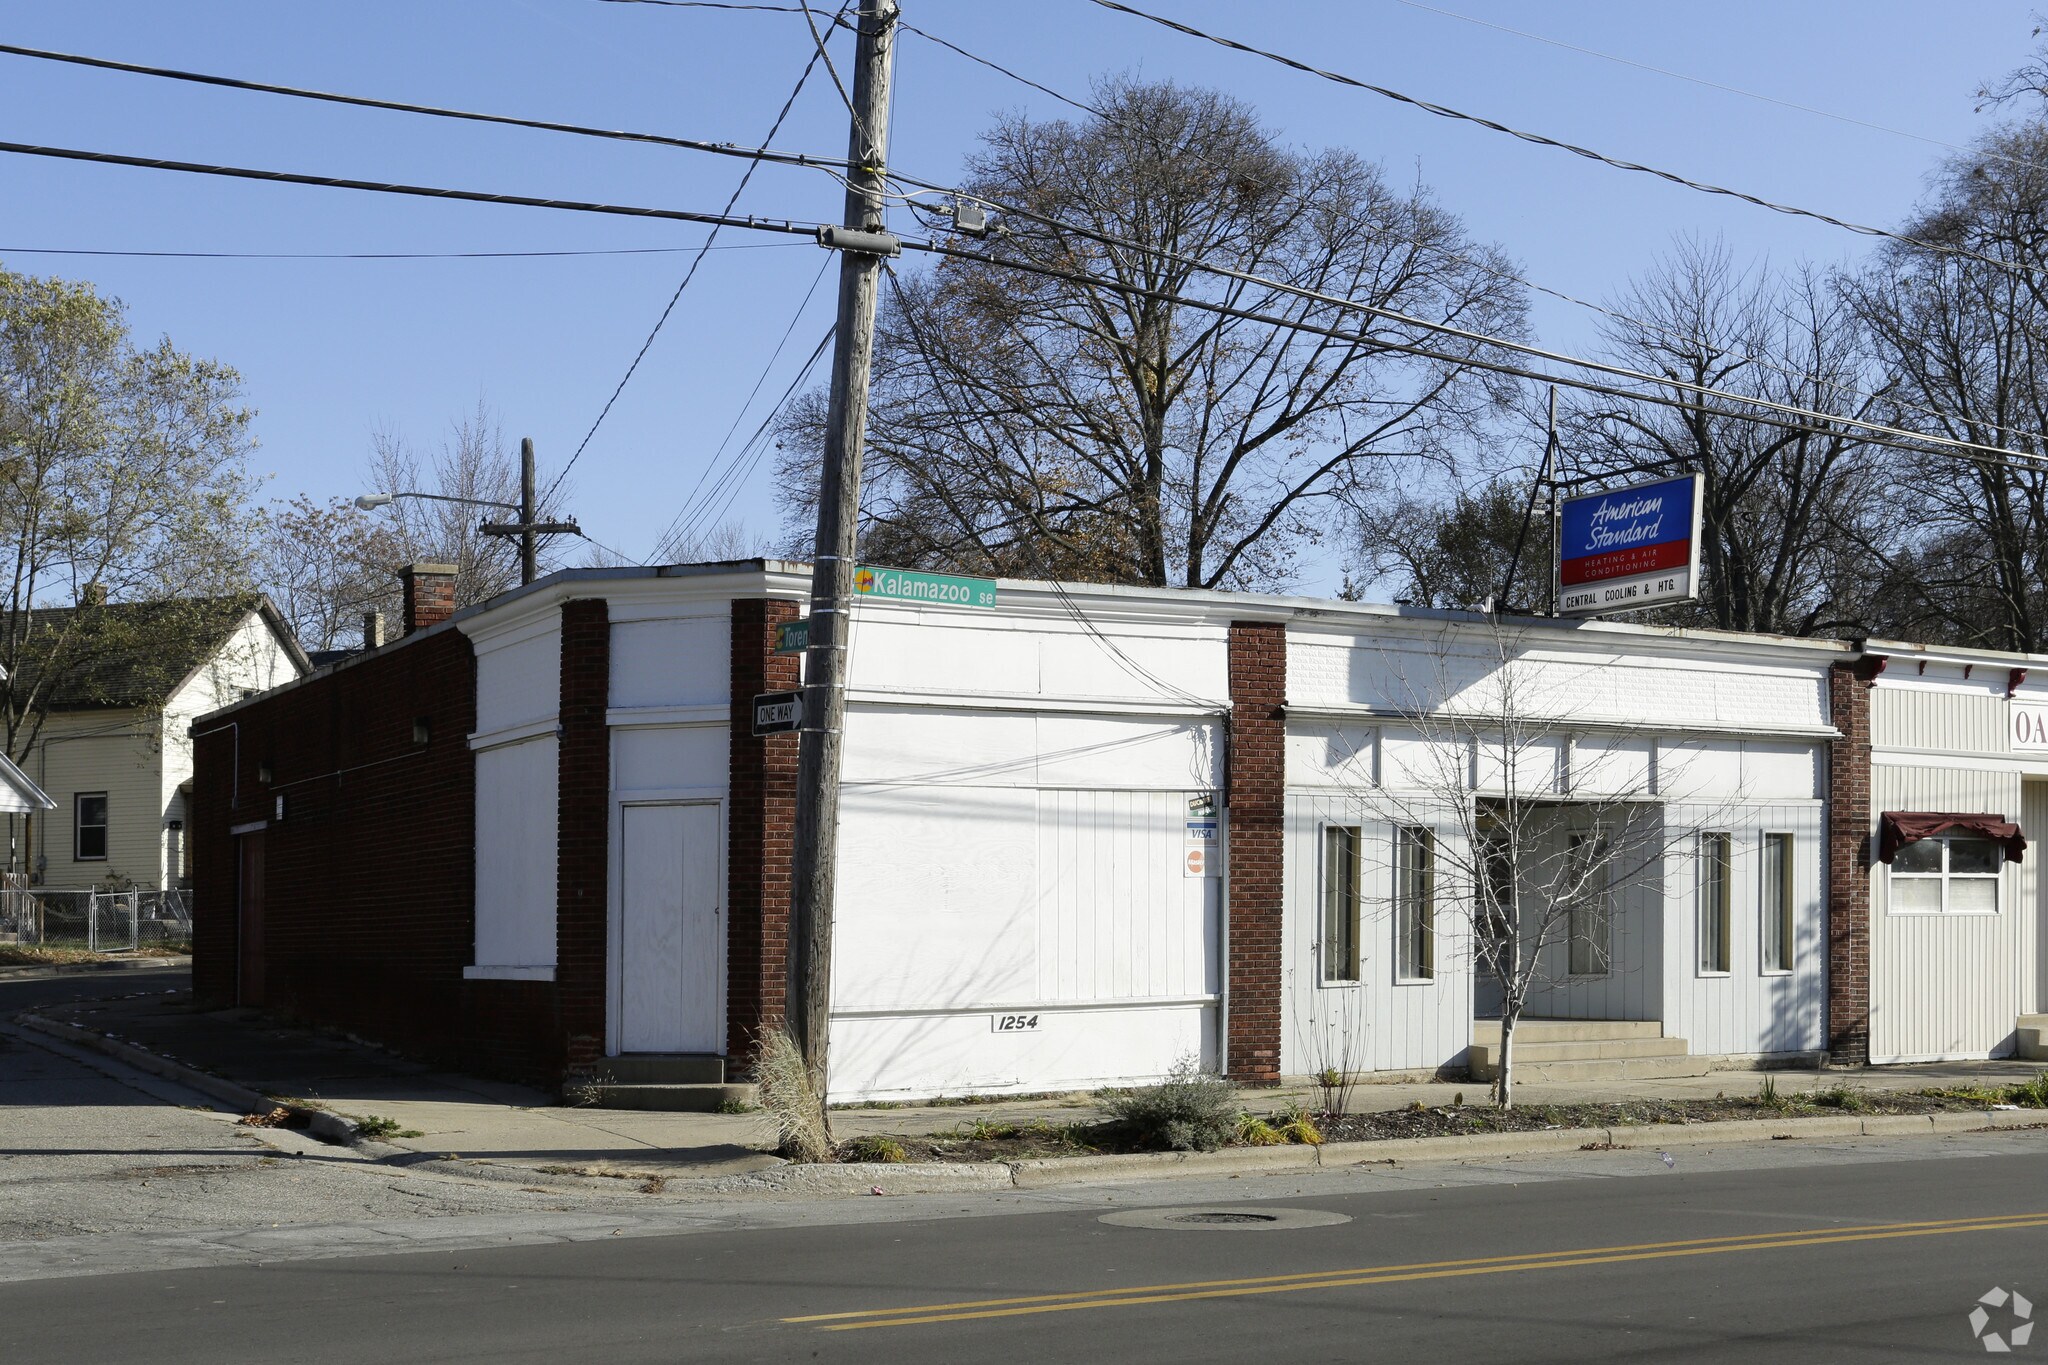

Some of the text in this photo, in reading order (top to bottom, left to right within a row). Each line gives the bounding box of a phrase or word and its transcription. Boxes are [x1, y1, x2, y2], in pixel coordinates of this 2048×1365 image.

[1590, 496, 1663, 527] American
[1584, 513, 1664, 550] Standard
[1584, 549, 1658, 568] HEATING & AIR
[1584, 559, 1657, 578] CONDITIONING
[873, 571, 971, 602] Kalamazoo
[1566, 593, 1598, 608] CENTRAL
[1605, 585, 1638, 602] COOLING
[1644, 583, 1650, 595] &
[760, 704, 794, 723] ONE WAY
[1192, 829, 1212, 839] VISA
[998, 1014, 1039, 1031] 1254
